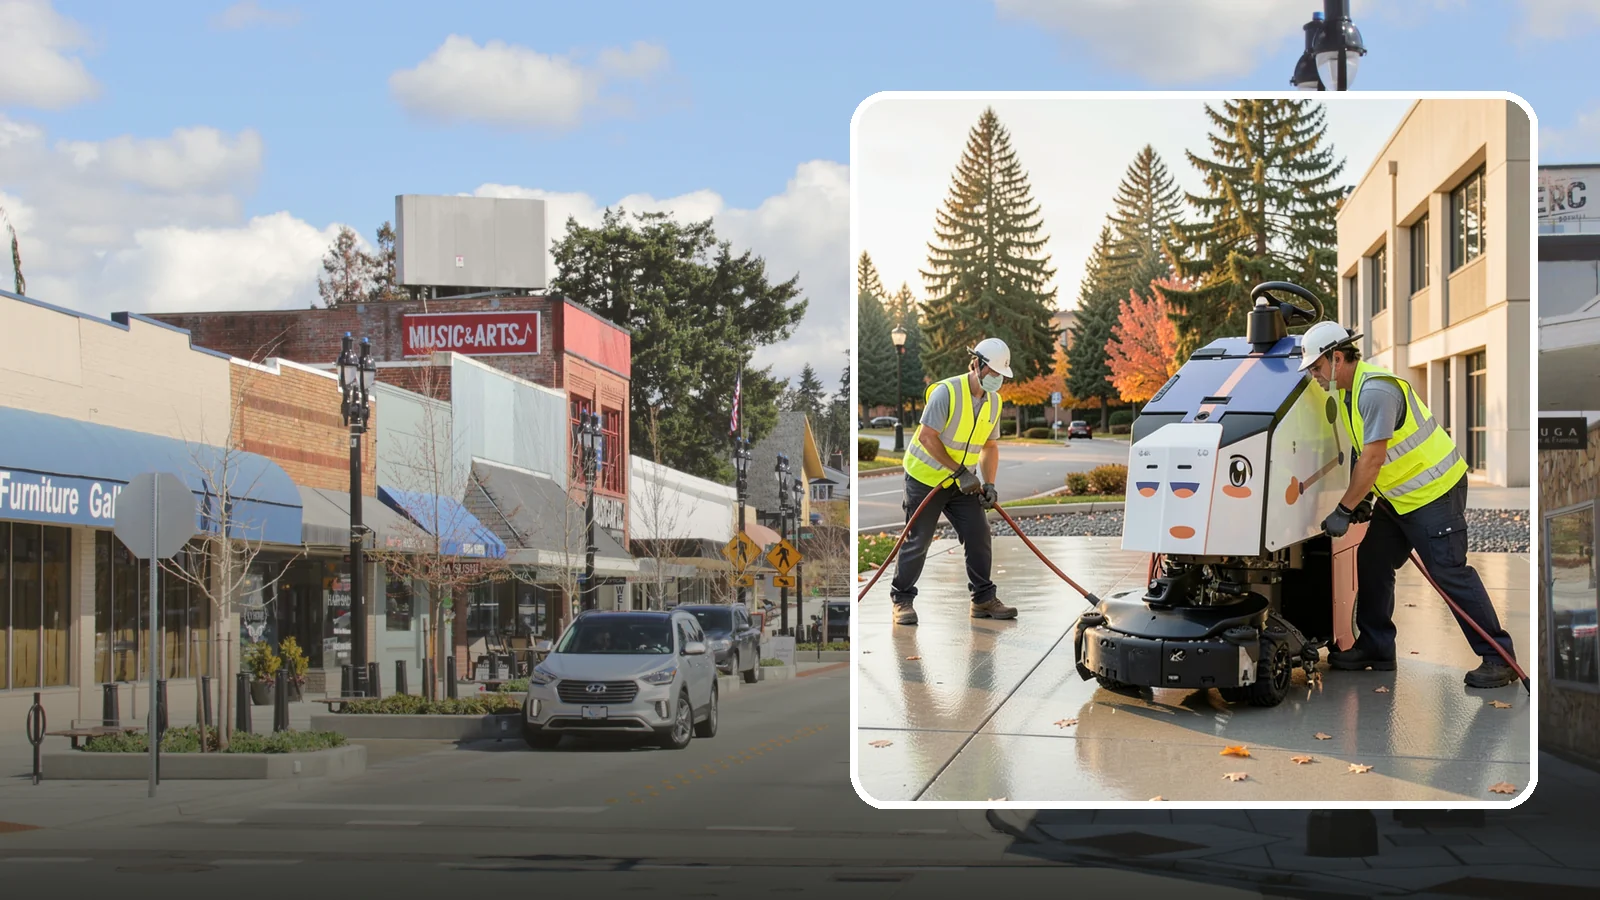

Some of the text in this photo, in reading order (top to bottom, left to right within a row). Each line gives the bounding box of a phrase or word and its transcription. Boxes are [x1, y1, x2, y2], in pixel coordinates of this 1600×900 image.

[1540, 427, 1577, 436] UGA
[0, 471, 122, 519] Furniture Gal
